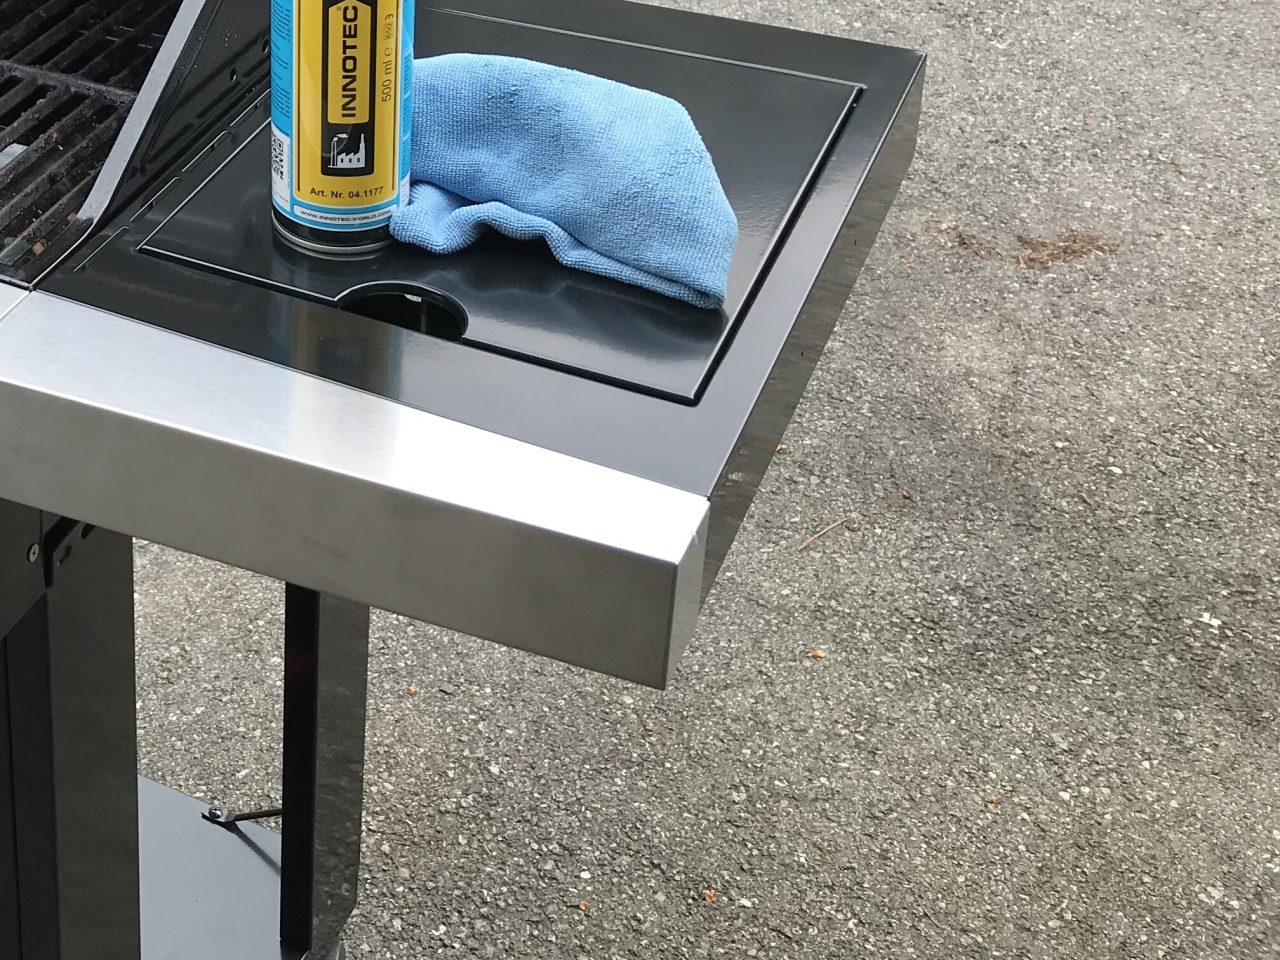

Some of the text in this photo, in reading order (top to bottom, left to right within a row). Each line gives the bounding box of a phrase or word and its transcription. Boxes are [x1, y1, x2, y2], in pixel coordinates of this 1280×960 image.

[341, 5, 359, 118] INNOTEC
[383, 60, 393, 76] ml
[381, 79, 392, 102] 500
[310, 186, 384, 199] Art. Nr. 04.1177
